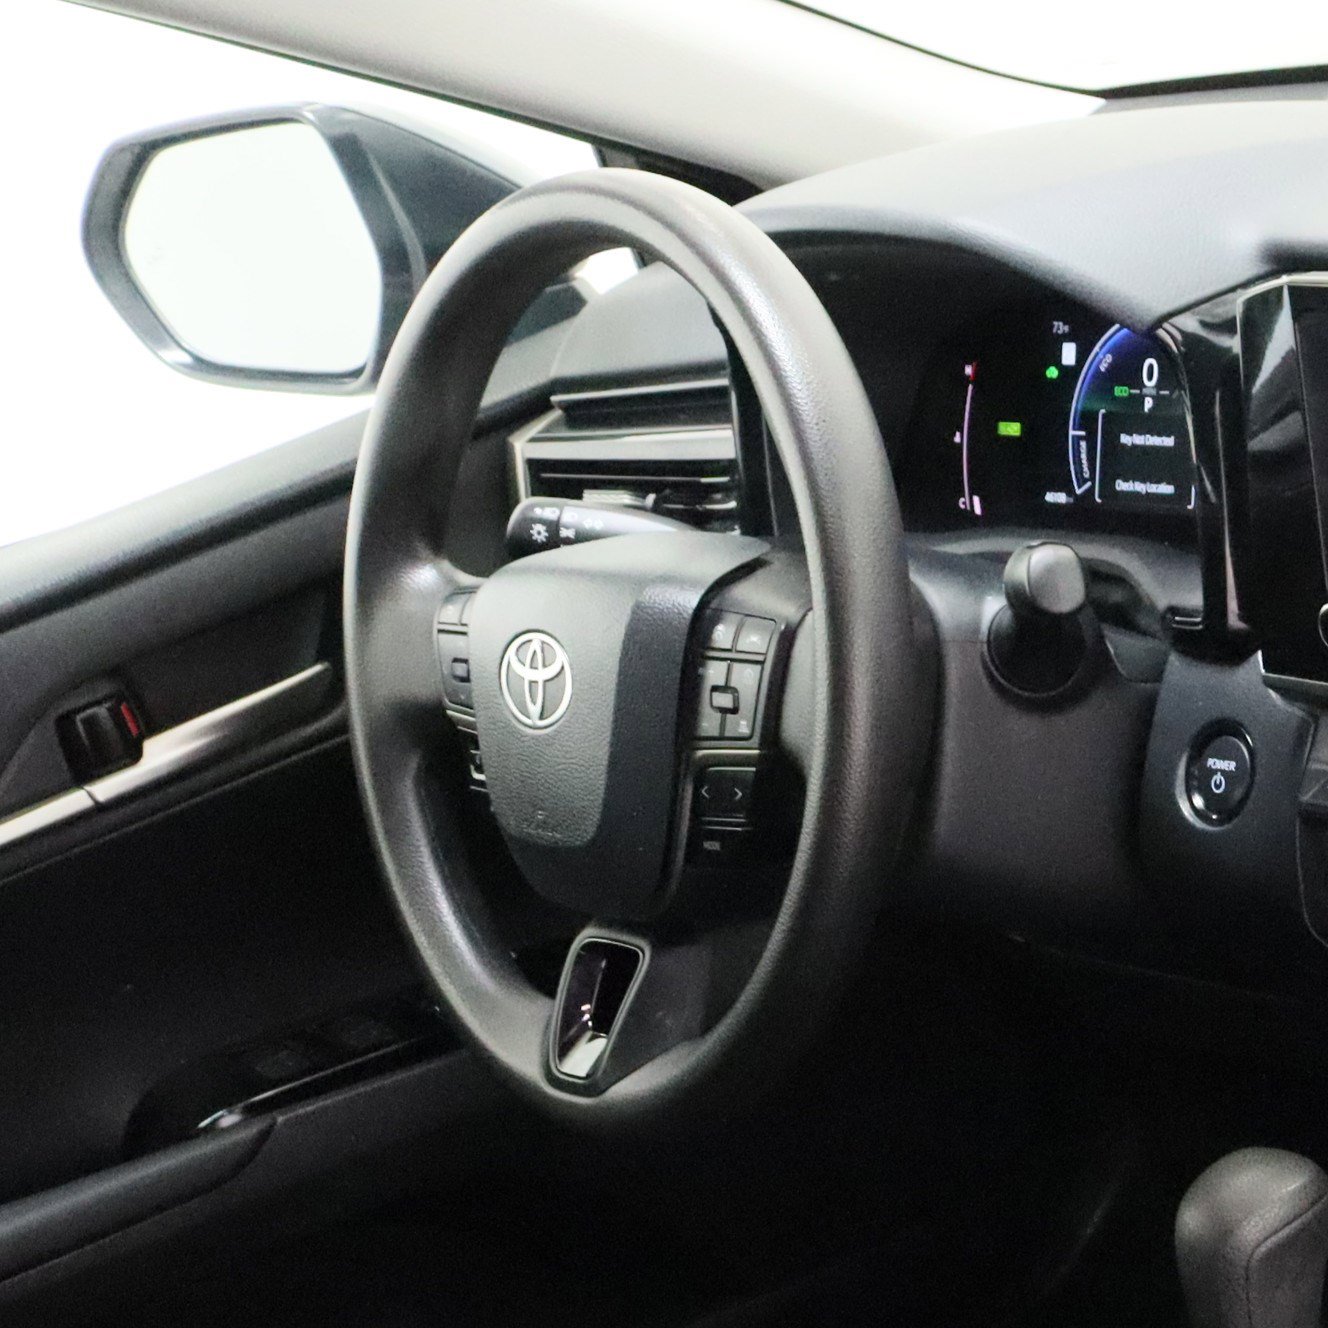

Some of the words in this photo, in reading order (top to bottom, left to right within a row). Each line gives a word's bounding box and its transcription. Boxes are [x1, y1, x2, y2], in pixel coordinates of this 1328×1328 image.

[1142, 358, 1159, 387] 0
[1144, 396, 1153, 412] P
[1207, 757, 1237, 772] POWER
